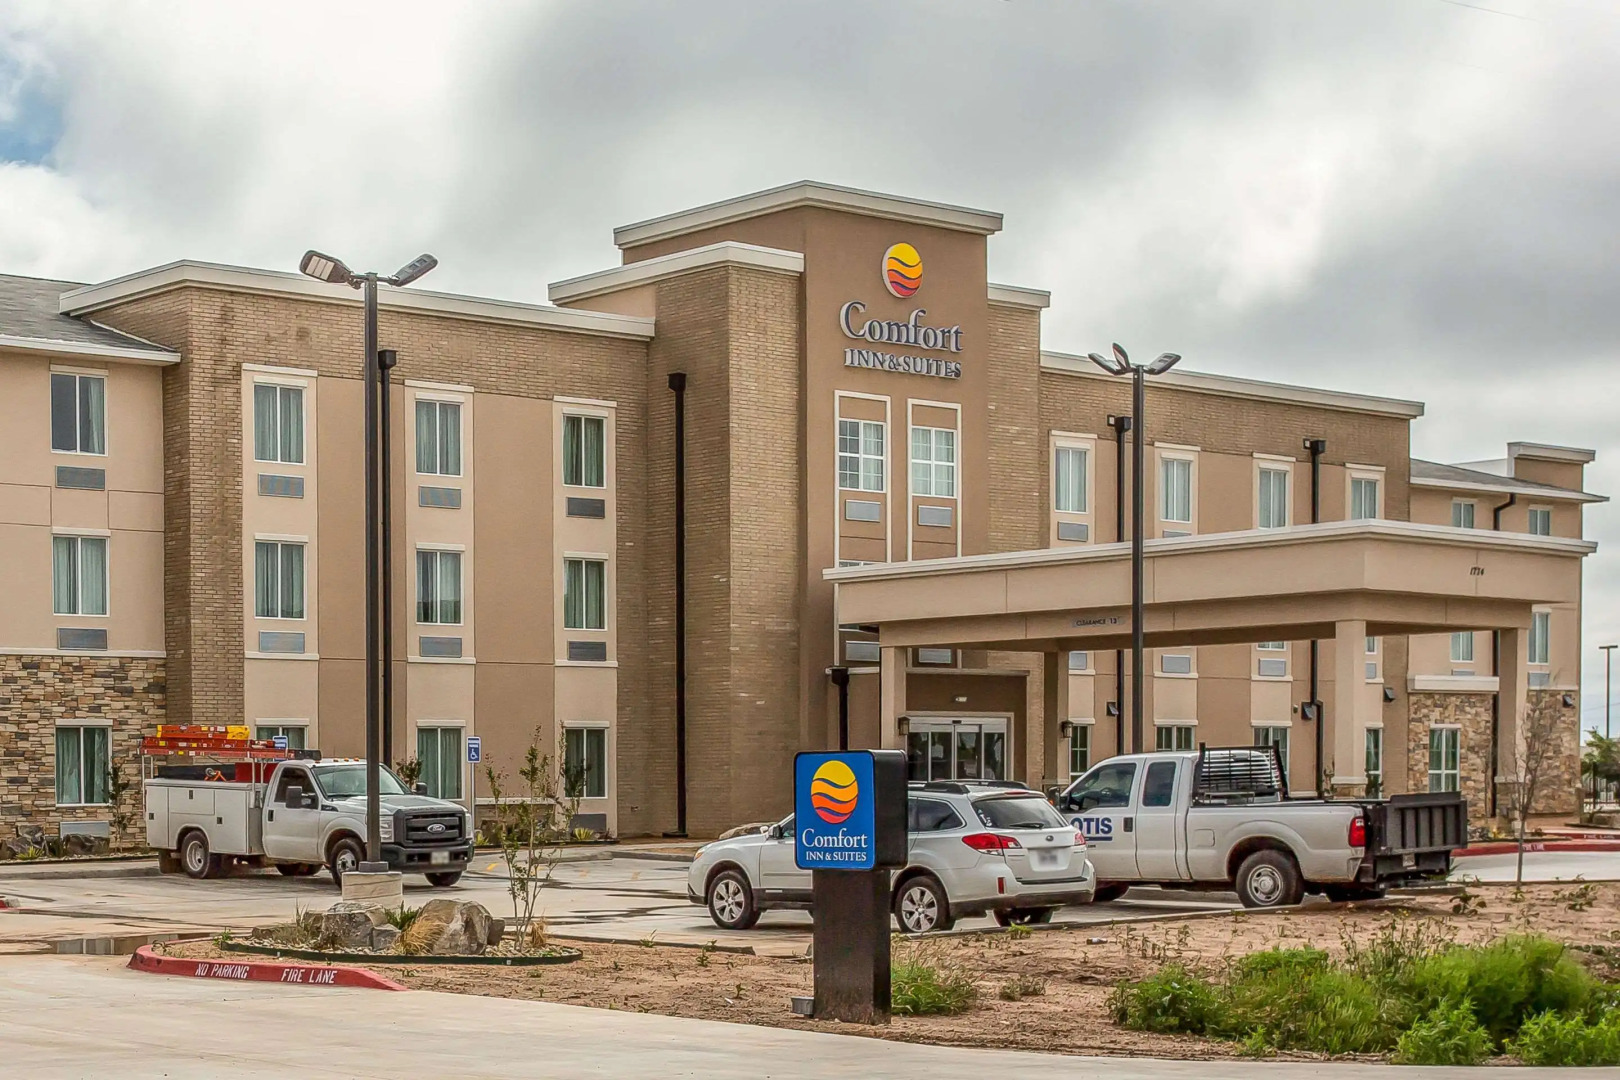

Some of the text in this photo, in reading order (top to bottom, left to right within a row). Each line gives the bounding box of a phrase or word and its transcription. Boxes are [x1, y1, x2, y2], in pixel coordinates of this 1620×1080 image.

[840, 301, 963, 352] Comfort
[844, 348, 885, 370] INN
[901, 355, 962, 380] SUITES
[1070, 817, 1112, 835] OTIS
[802, 827, 868, 848] Comfort
[806, 851, 867, 862] INN & SUITES
[195, 962, 338, 985] NO PARKING FIRE LANE
